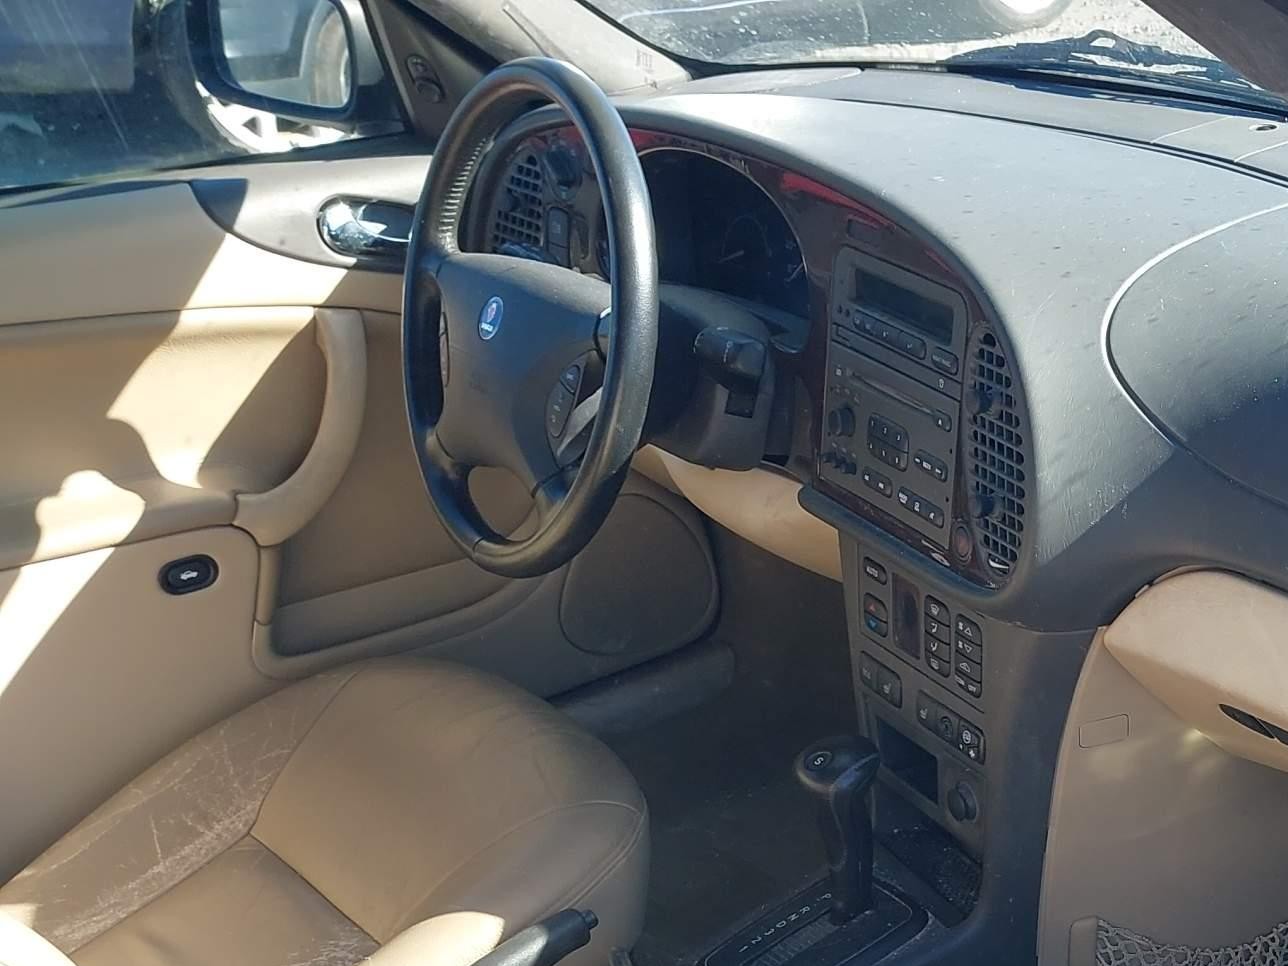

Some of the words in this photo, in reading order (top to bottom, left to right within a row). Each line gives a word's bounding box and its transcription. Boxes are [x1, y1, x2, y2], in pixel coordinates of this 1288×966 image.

[814, 757, 824, 765] S
[799, 906, 811, 914] R
[787, 913, 800, 922] N
[775, 920, 787, 928] D
[751, 936, 762, 944] 2
